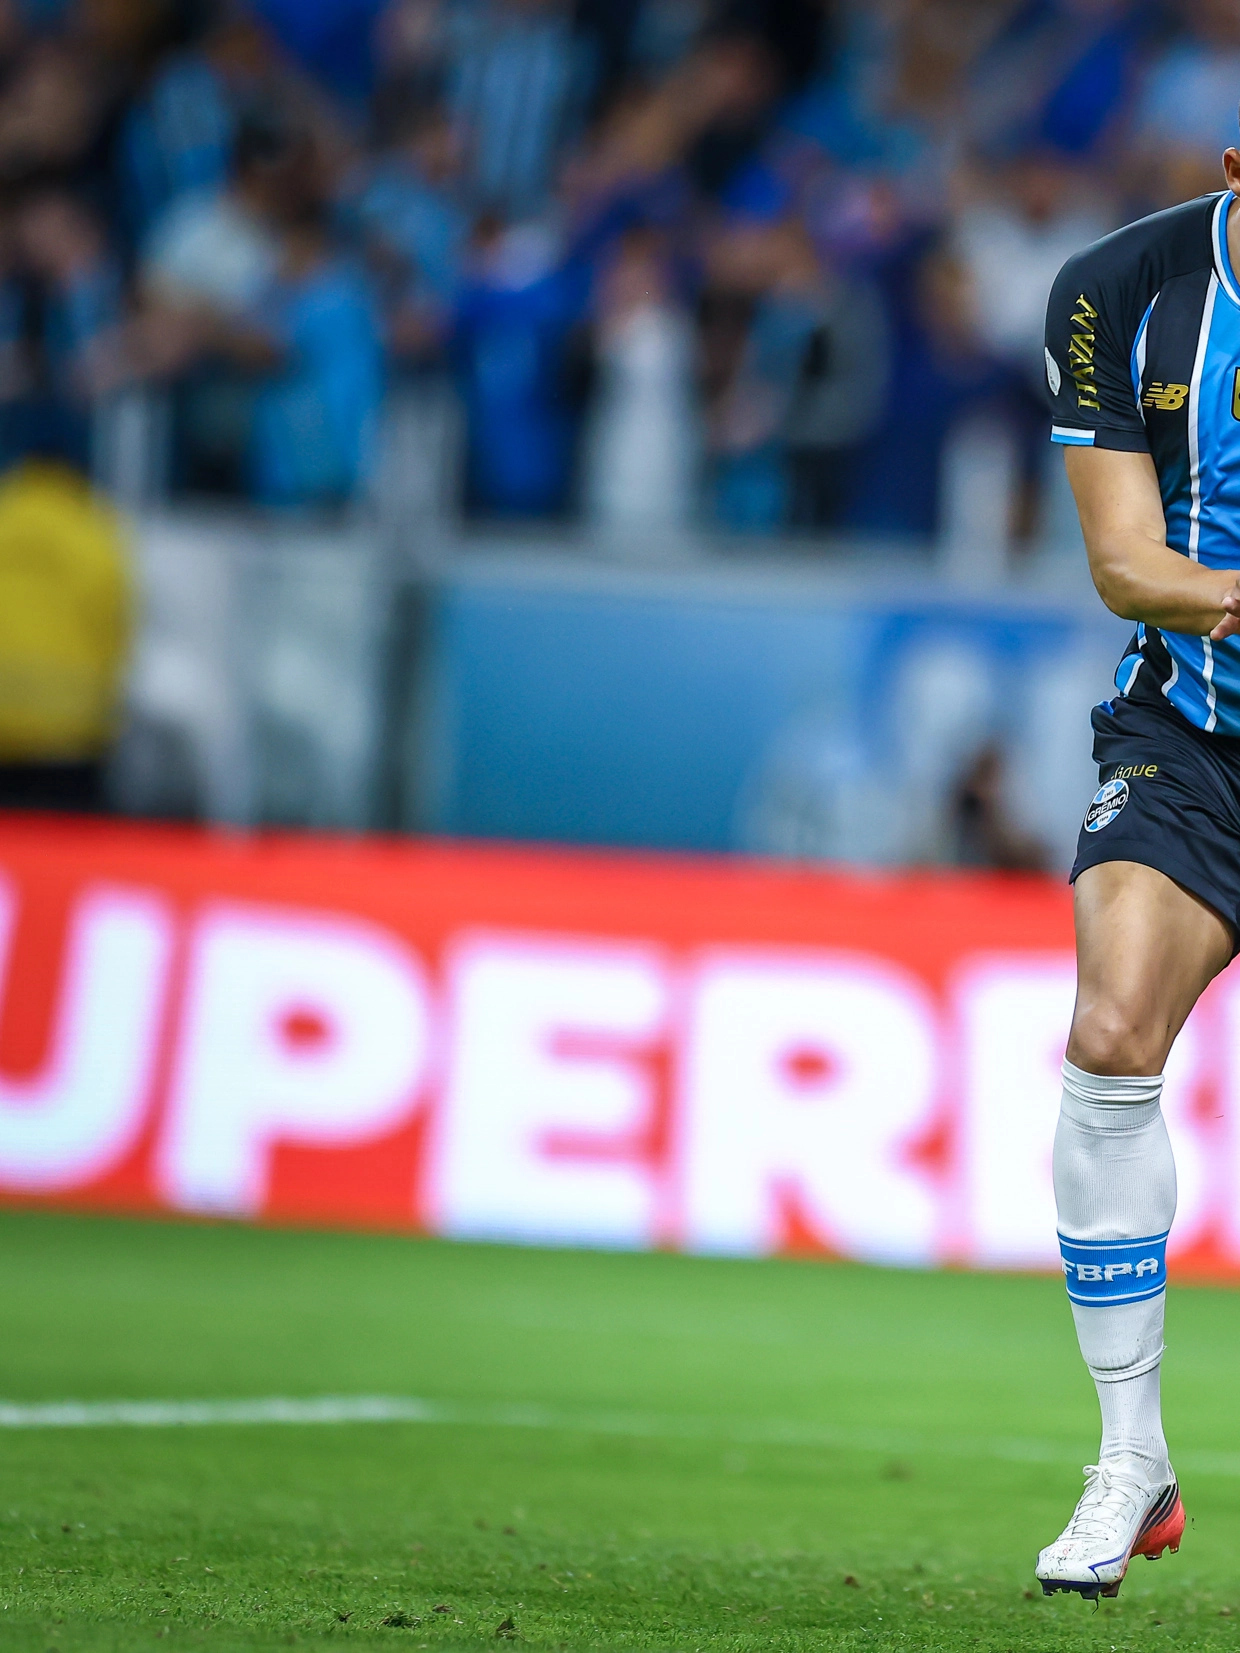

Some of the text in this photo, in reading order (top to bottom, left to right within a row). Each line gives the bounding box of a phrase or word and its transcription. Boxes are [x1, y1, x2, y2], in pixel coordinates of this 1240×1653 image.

[1068, 293, 1101, 412] HAVAN
[1087, 793, 1127, 821] GRÊMIO
[1061, 1256, 1159, 1282] FBPA
